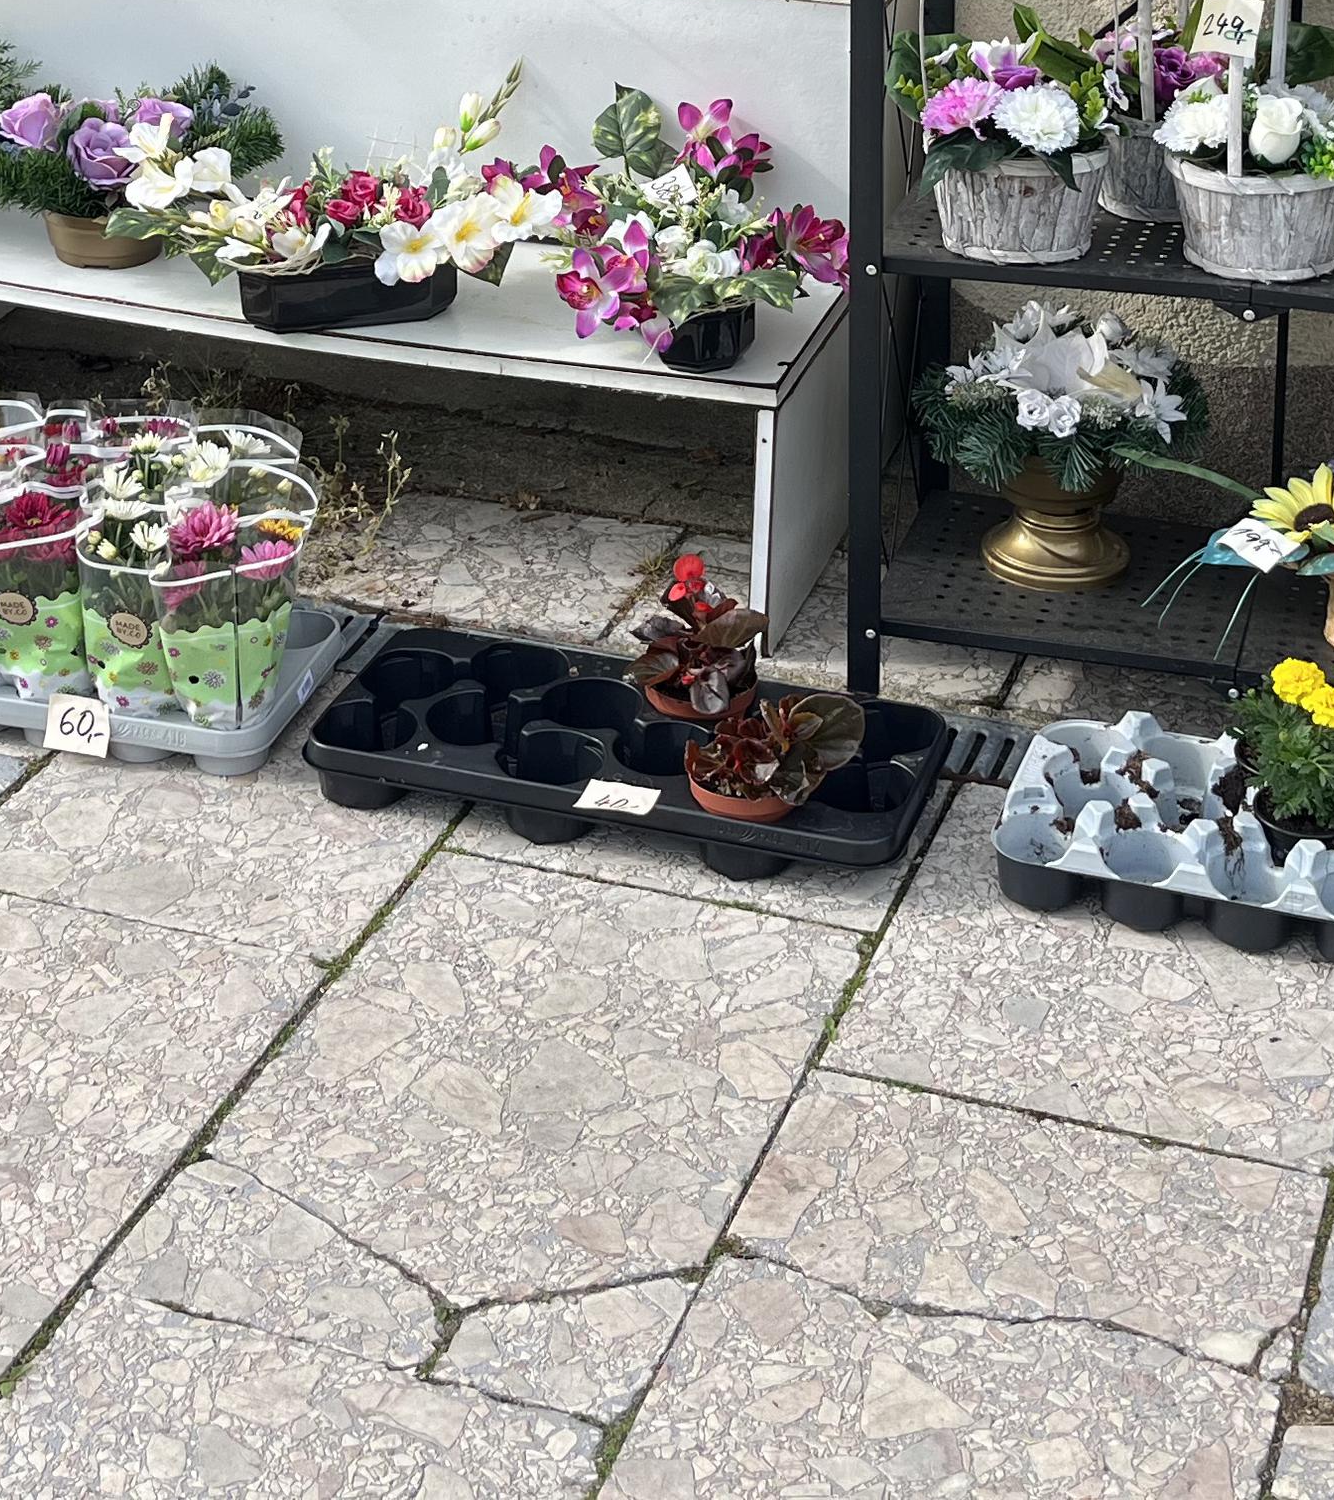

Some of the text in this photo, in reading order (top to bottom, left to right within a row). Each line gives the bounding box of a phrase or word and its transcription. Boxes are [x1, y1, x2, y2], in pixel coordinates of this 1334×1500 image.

[0, 601, 24, 609] MADE
[116, 620, 140, 630] MADE
[60, 707, 104, 743] 60,-
